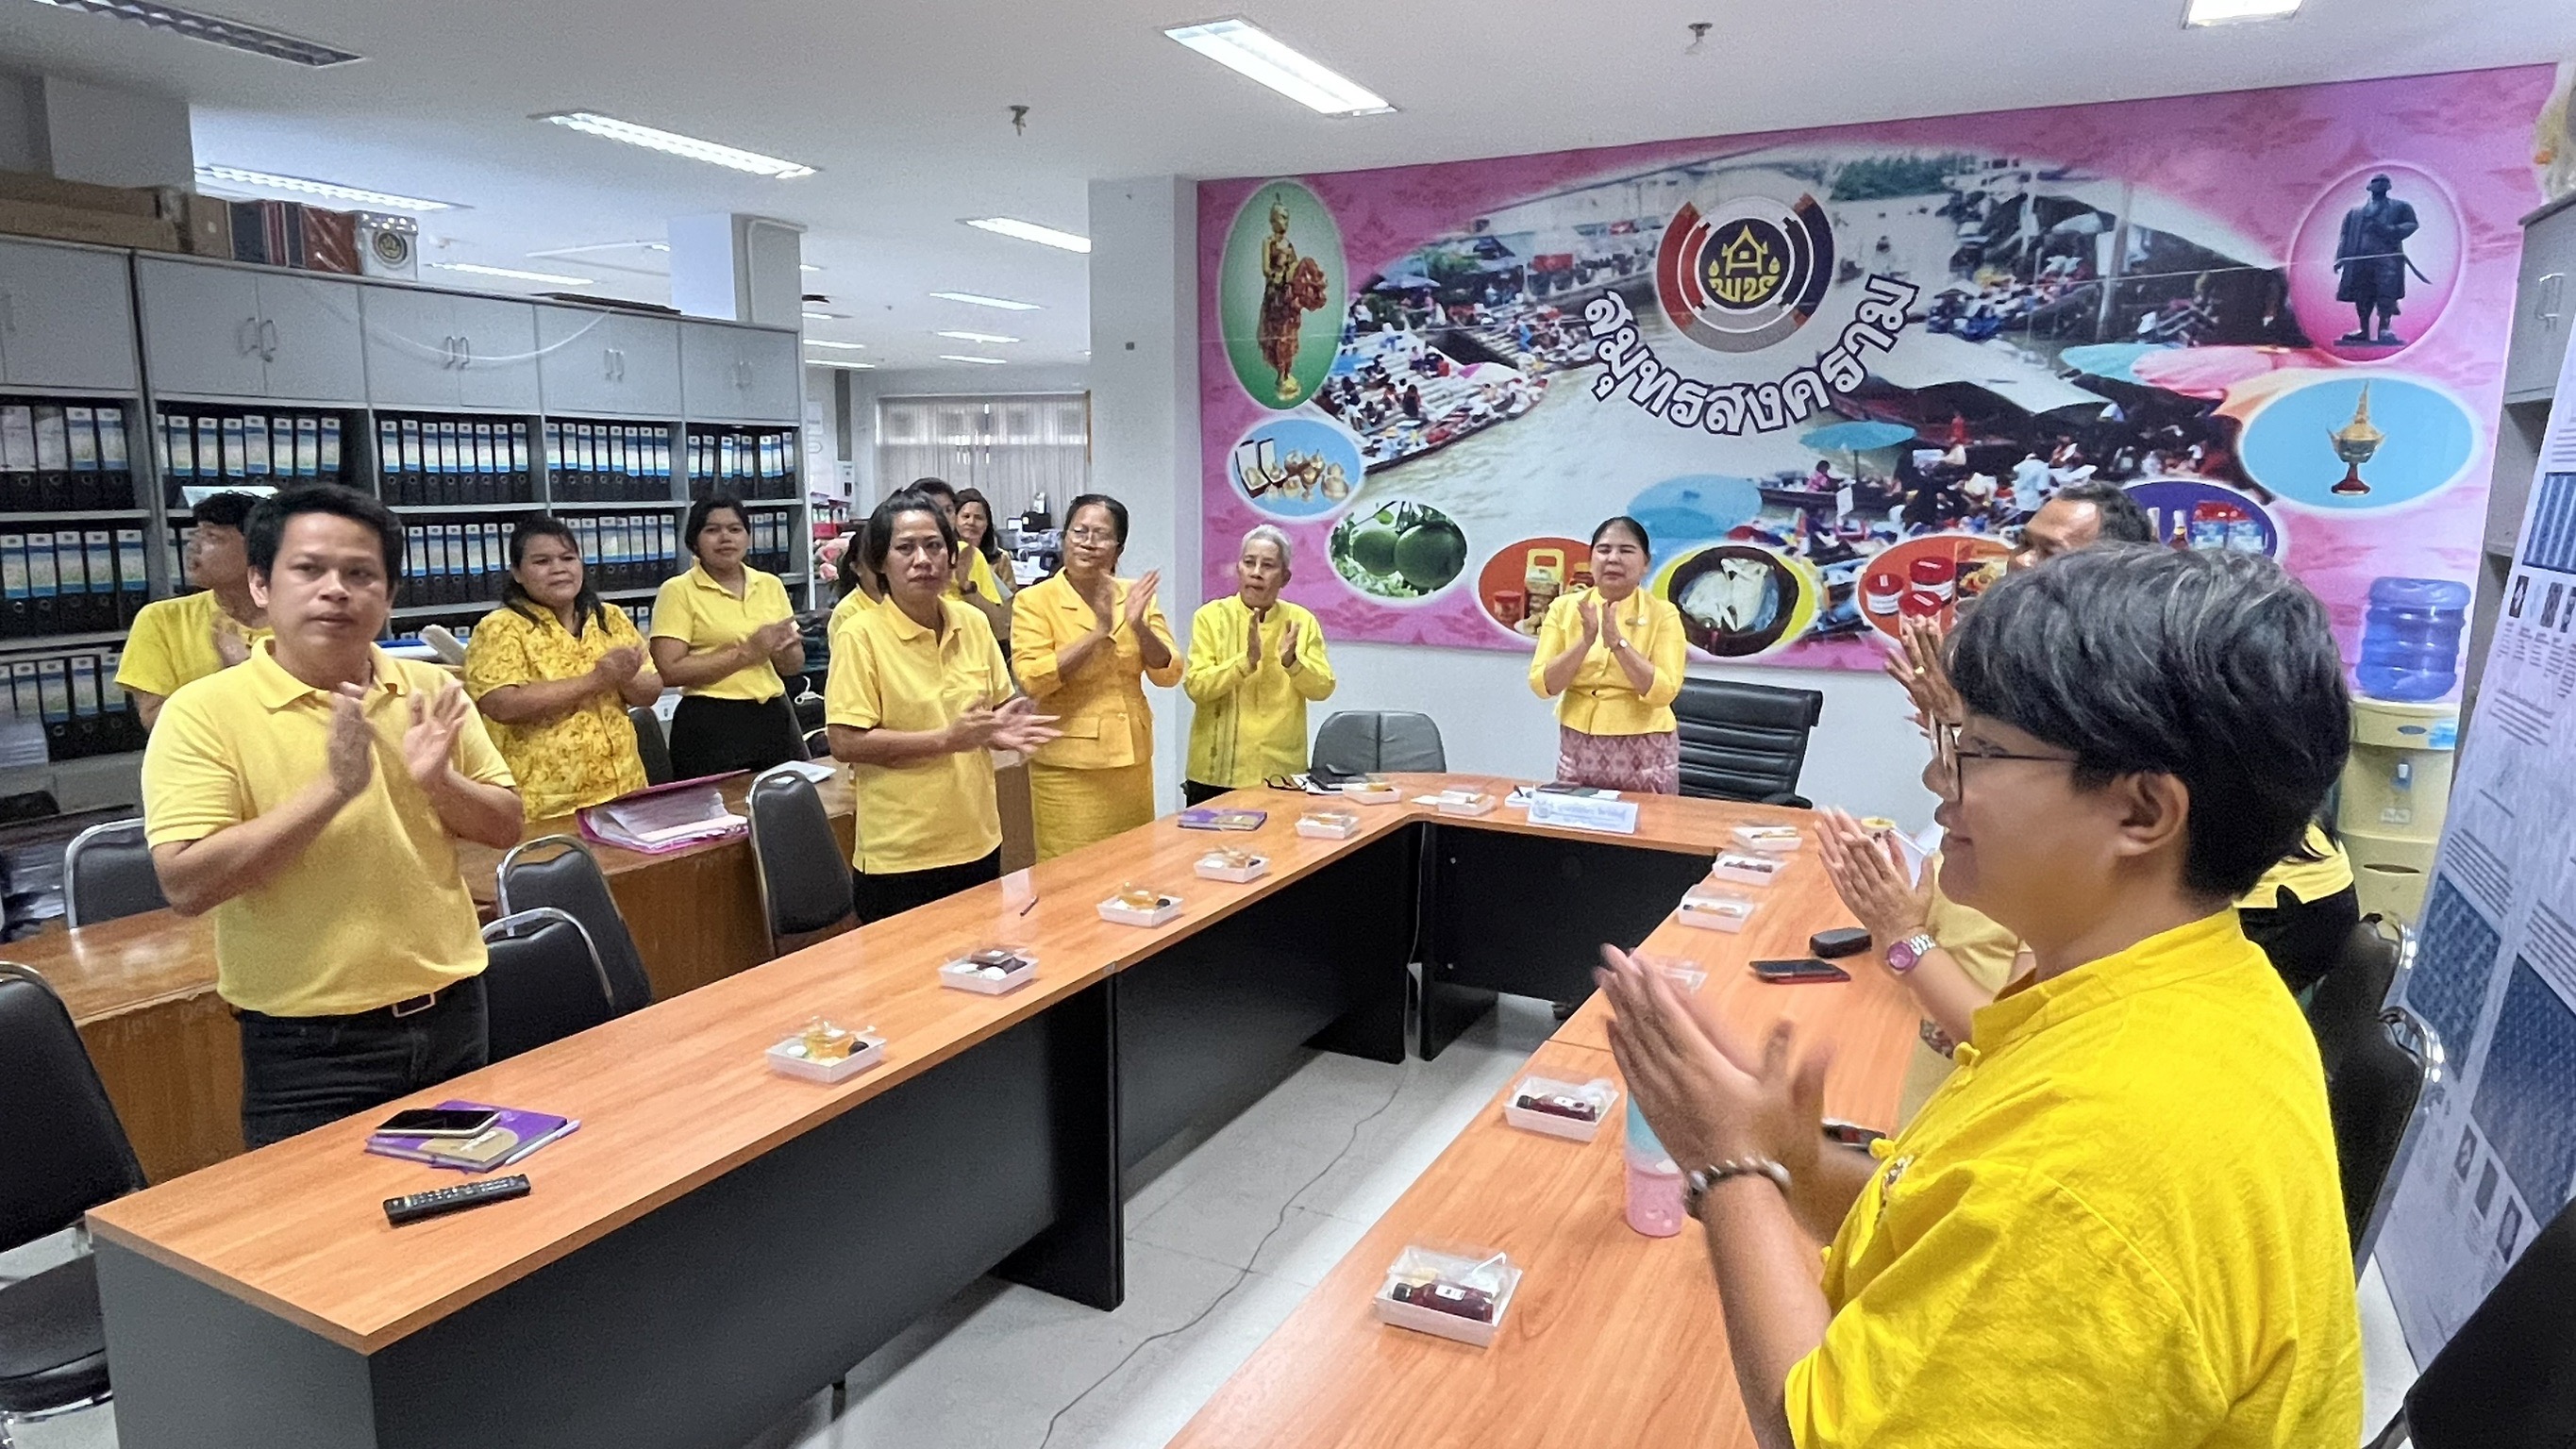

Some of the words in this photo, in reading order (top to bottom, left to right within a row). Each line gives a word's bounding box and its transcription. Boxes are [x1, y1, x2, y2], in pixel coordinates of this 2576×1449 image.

[1584, 275, 1920, 436] สมุทรสงคราม
